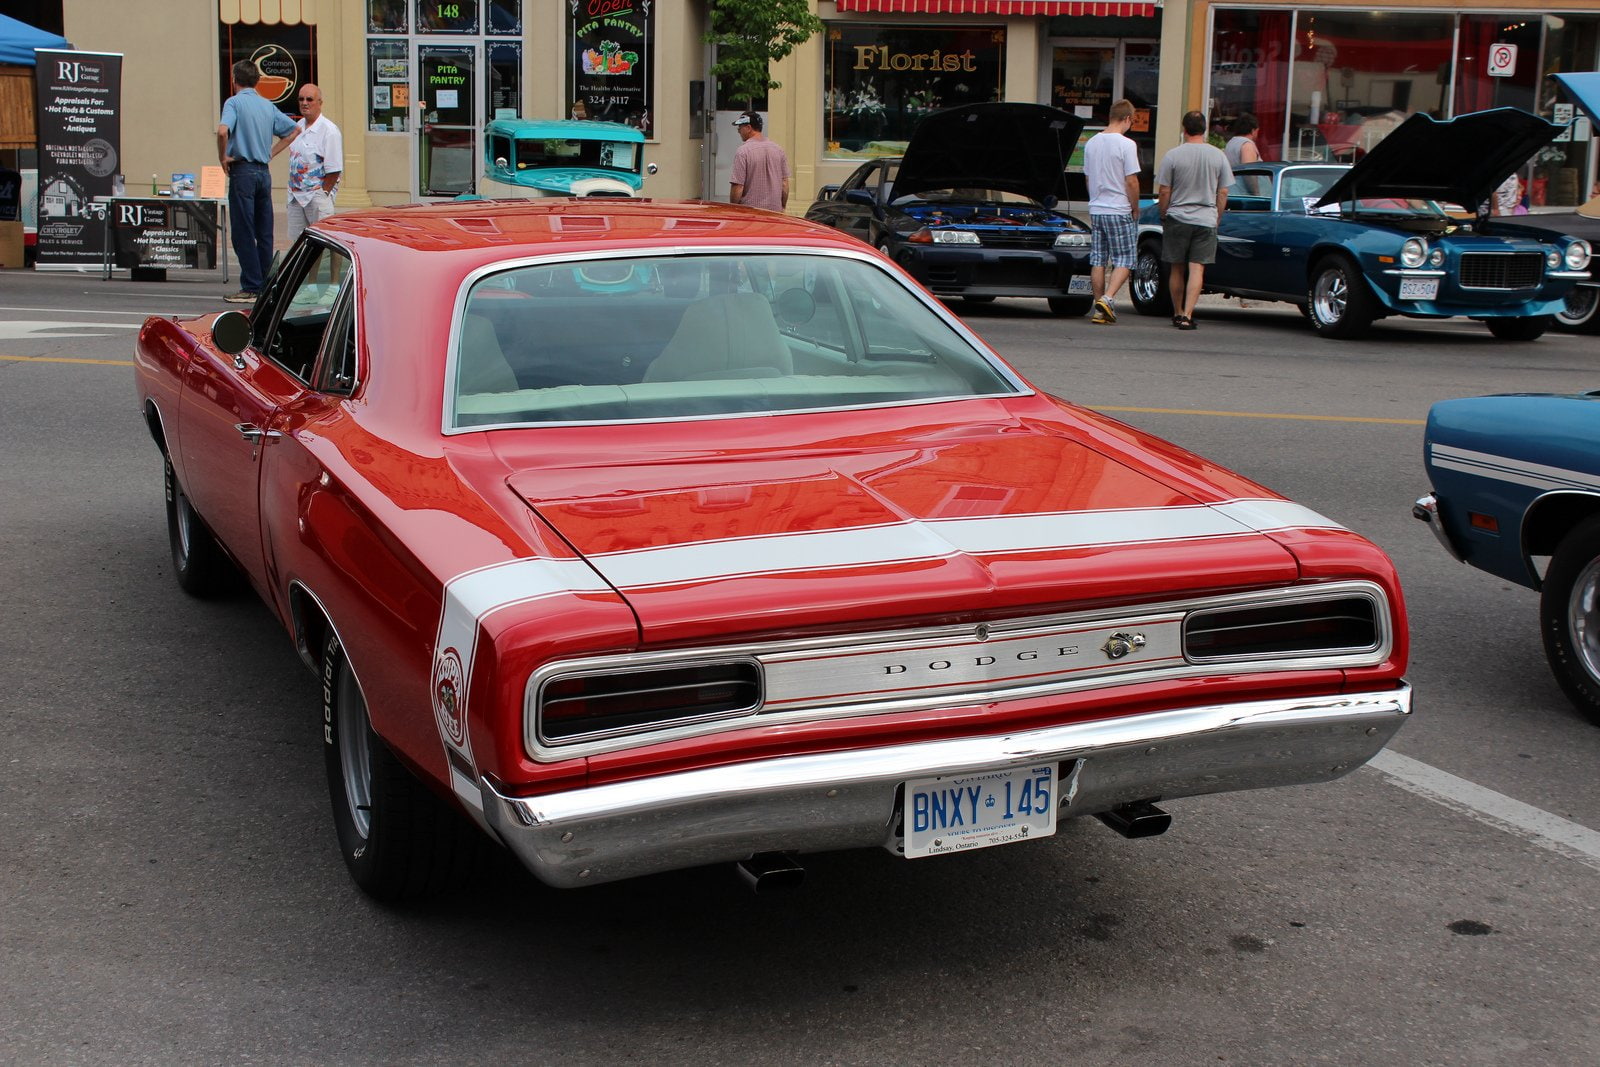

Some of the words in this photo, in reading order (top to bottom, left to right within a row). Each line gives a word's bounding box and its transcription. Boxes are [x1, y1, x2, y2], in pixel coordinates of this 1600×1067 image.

[437, 4, 459, 18] 148
[588, 0, 632, 16] Open
[577, 21, 599, 37] PITA
[604, 18, 643, 37] PANTRY
[853, 45, 976, 71] Florist
[58, 62, 80, 82] RJ
[437, 66, 458, 74] PITA
[430, 76, 465, 84] PANTRY
[55, 96, 89, 105] Appraisals
[589, 96, 629, 104] 324-8117
[67, 125, 96, 133] Antiques
[120, 205, 143, 226] RJ
[328, 636, 340, 657] T/A
[884, 646, 1078, 675] DODGE
[324, 656, 335, 744] Radial
[914, 785, 981, 832] BNXY
[1003, 776, 1050, 819] 145
[928, 844, 953, 854] Lindsay,
[956, 841, 978, 850] Ontario
[989, 832, 1028, 844] 705-324-5544
